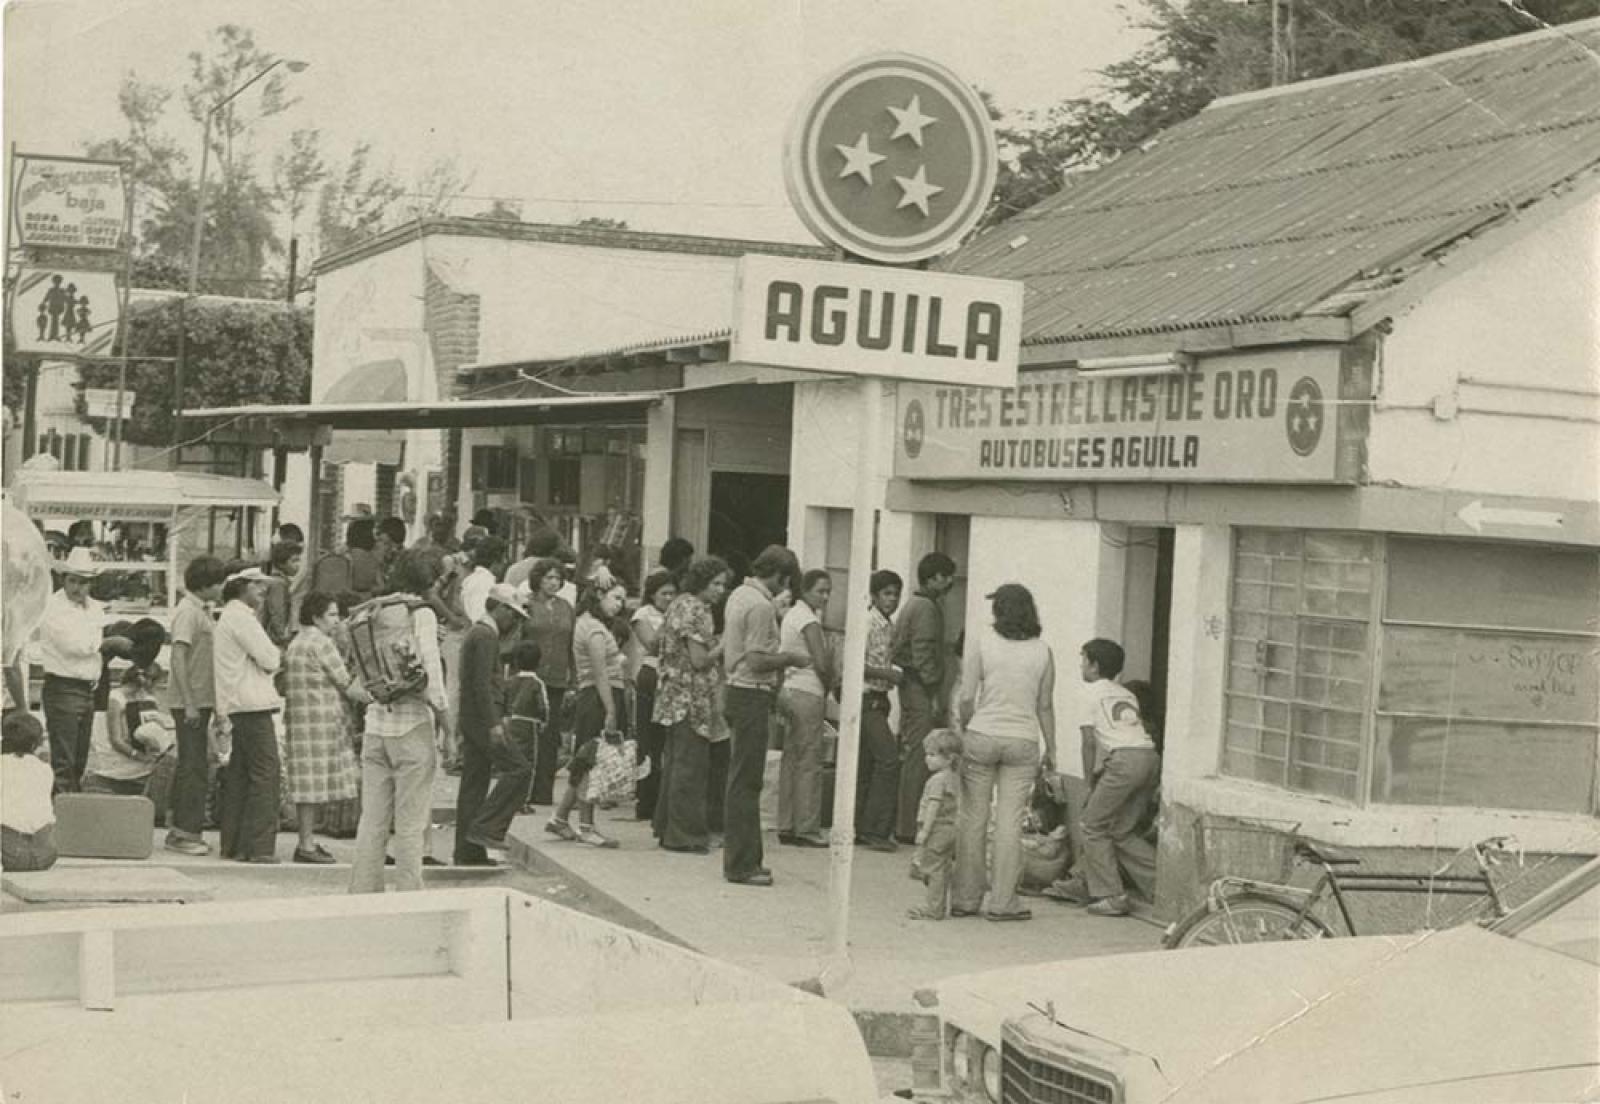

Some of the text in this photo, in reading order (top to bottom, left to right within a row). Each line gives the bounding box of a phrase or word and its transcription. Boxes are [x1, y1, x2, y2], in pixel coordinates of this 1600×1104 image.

[65, 191, 105, 214] baja
[765, 280, 1002, 362] AGUILA
[936, 368, 1278, 429] TRES ESTRELLAS DE ORO
[980, 435, 1199, 469] AUTOBUSES AGUILA
